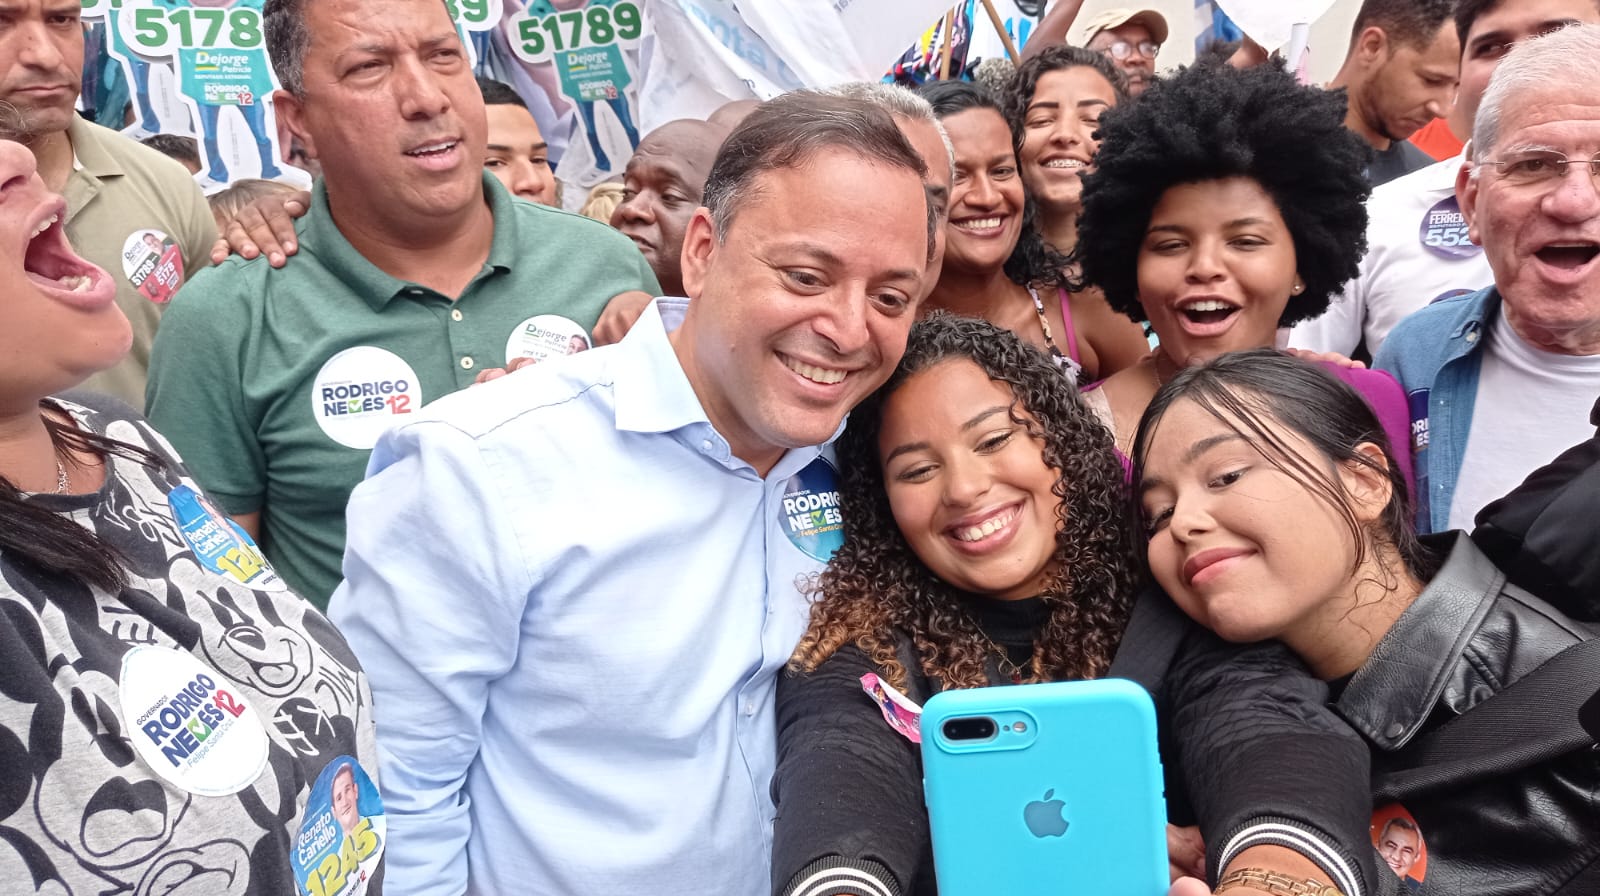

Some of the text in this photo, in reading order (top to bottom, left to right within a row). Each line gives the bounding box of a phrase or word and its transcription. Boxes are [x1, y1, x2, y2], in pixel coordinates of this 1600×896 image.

[135, 8, 262, 48] 5178
[519, 2, 642, 55] 51789
[196, 51, 248, 66] Dejorge
[568, 52, 608, 66] Dejorge
[205, 84, 250, 93] RODRIGO
[237, 93, 252, 104] 12
[1424, 227, 1473, 247] 552
[131, 259, 156, 286] 51789
[157, 262, 175, 286] 5178
[526, 323, 567, 343] Dejorge
[321, 379, 409, 402] RODRIGO
[385, 394, 412, 415] 12
[136, 694, 169, 726] GOVERNADOR
[142, 673, 216, 746] RODRIGO
[212, 689, 246, 718] 12
[187, 745, 210, 768] Felipe
[298, 811, 331, 850] Renato
[298, 825, 336, 866] Cariello
[305, 817, 379, 896] 1245
